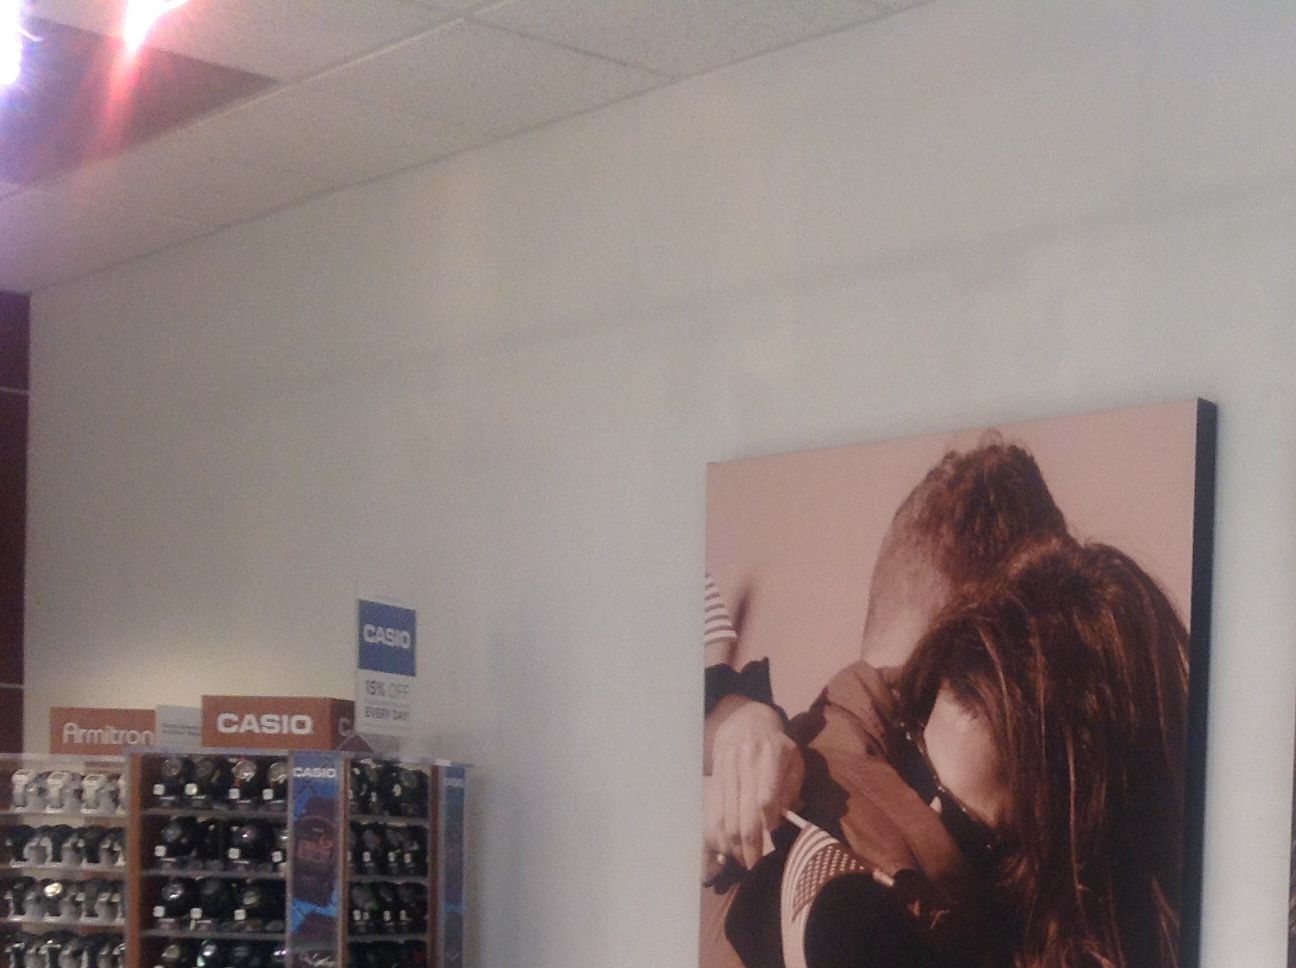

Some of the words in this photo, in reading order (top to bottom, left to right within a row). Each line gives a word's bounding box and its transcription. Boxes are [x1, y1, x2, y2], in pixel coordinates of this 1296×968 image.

[363, 623, 411, 649] CASIO
[62, 721, 154, 745] Armitron
[217, 712, 313, 735] CASIO
[293, 767, 336, 779] CASIO
